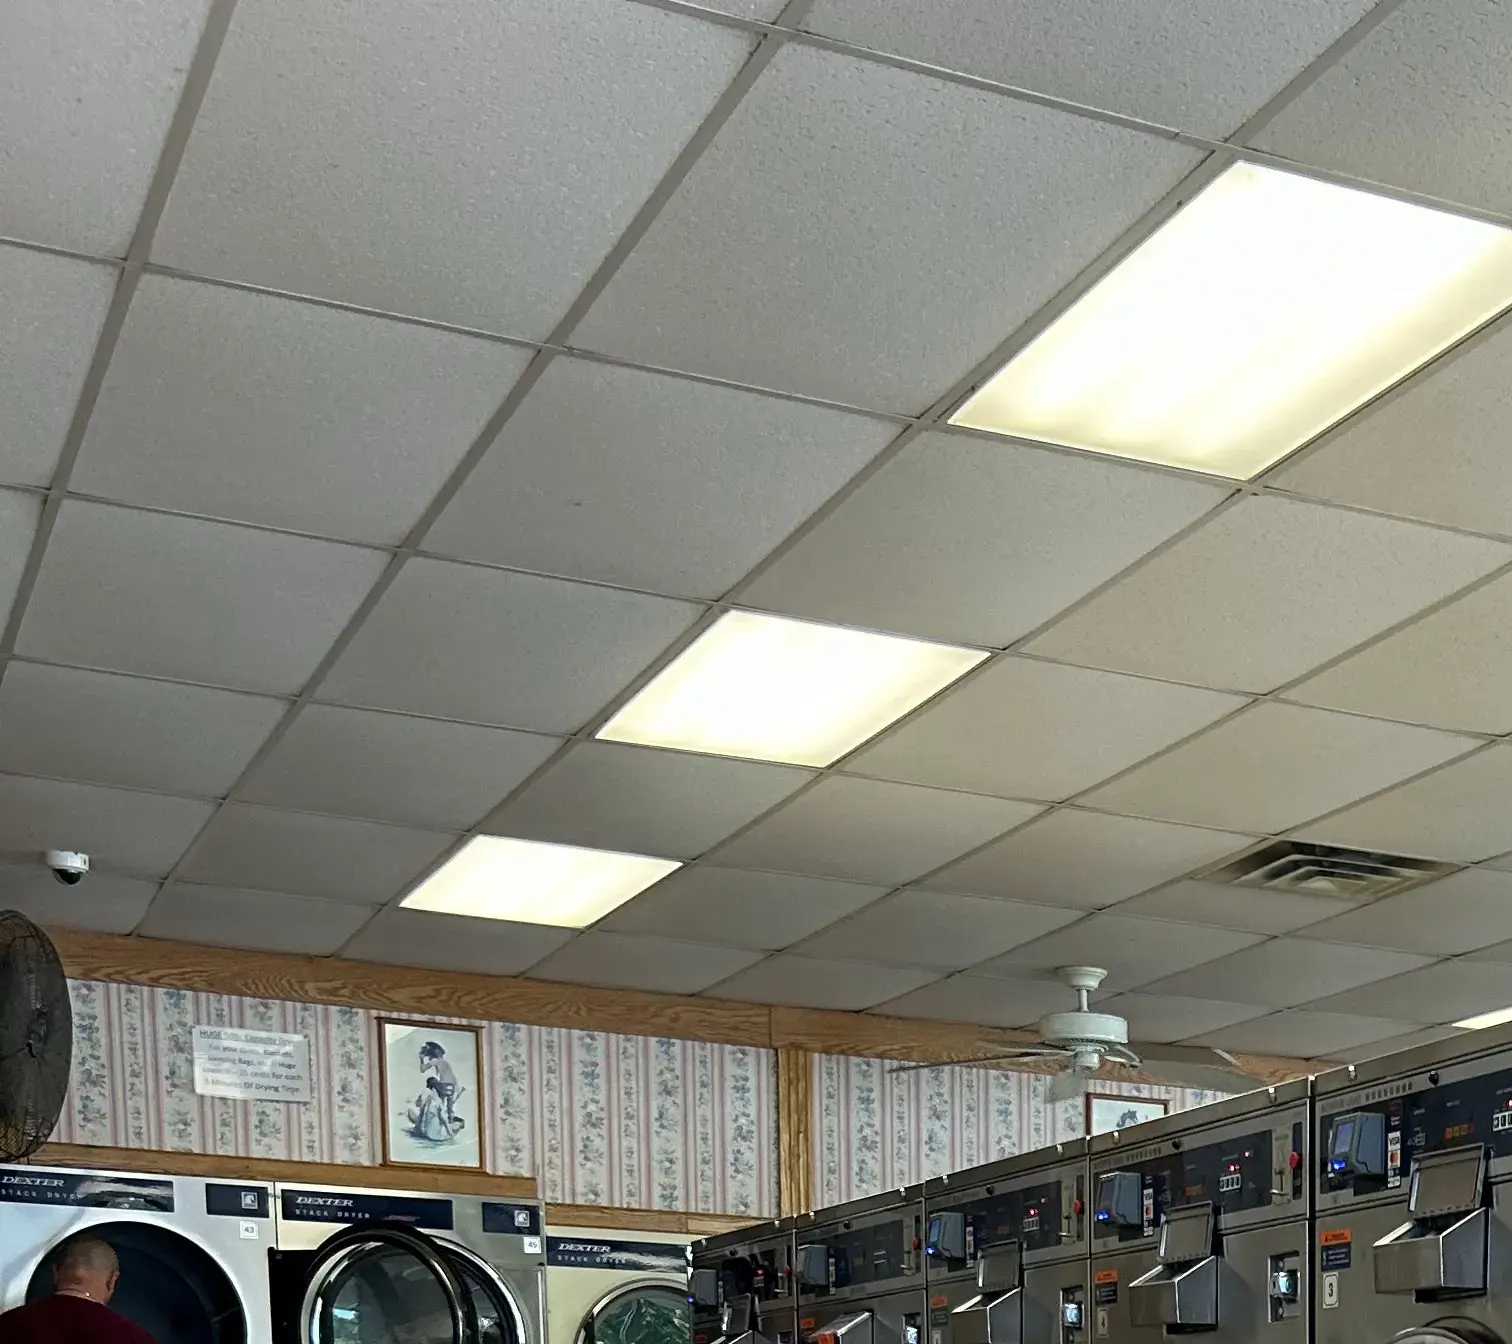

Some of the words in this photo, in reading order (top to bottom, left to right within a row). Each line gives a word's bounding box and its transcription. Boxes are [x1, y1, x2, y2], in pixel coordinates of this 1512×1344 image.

[200, 1030, 223, 1040] HUGE
[1, 1175, 65, 1187] DEXTER
[295, 1196, 355, 1207] DEXTER
[557, 1243, 611, 1253] DEXTER
[1328, 1282, 1334, 1298] 3
